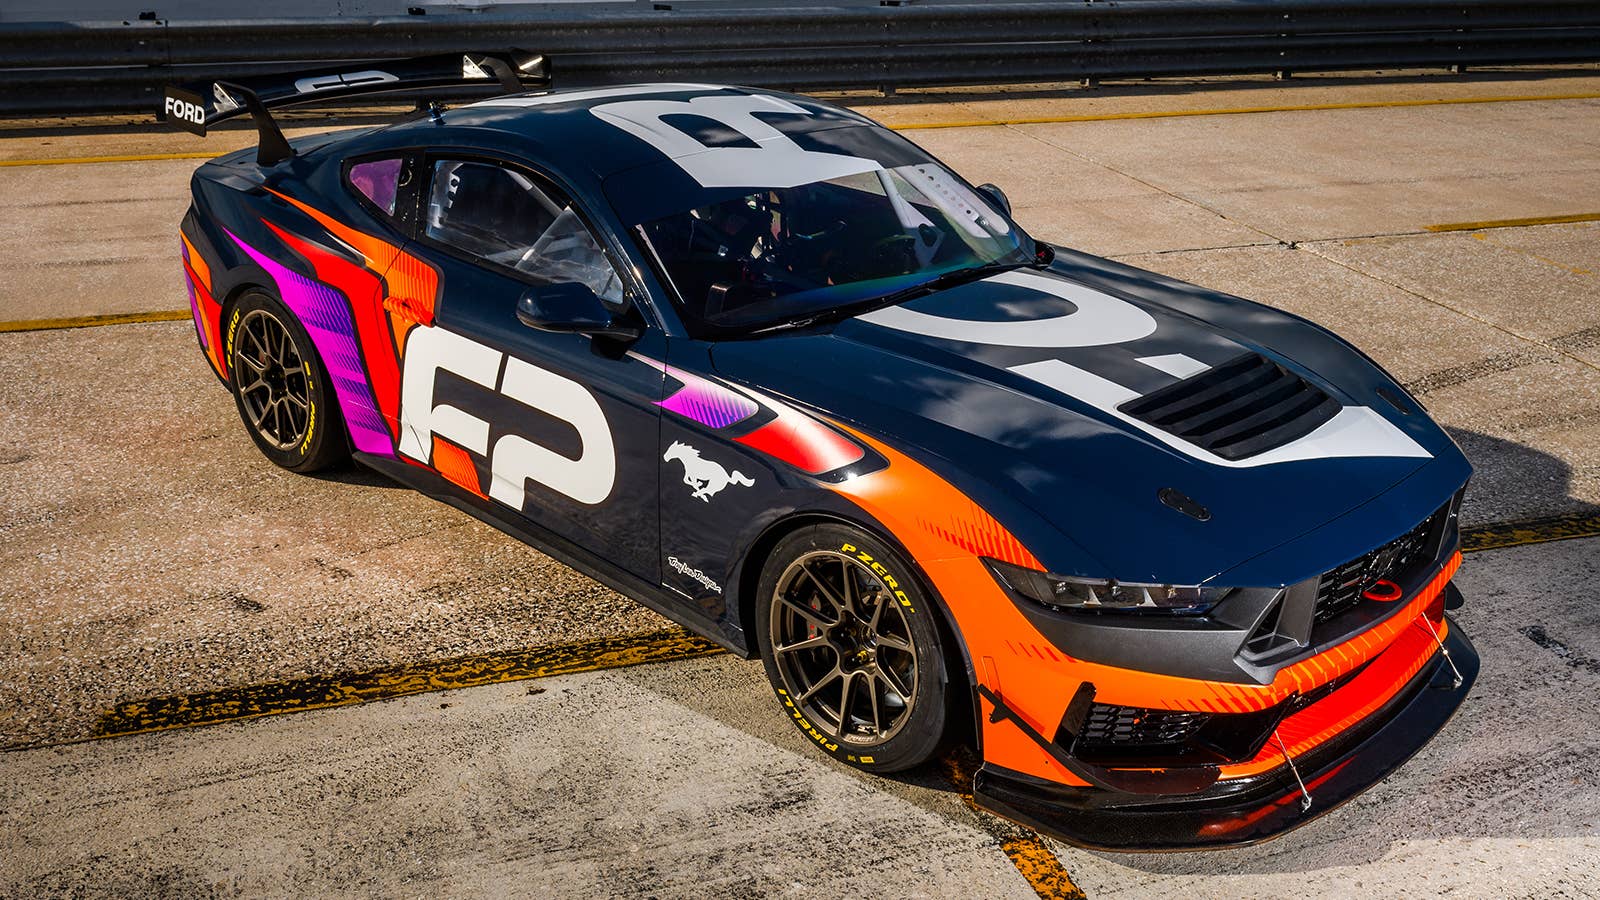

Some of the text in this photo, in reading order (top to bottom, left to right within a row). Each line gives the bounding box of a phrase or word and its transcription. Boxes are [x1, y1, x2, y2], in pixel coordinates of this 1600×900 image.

[165, 96, 205, 124] FORD
[398, 325, 616, 512] FP
[841, 543, 911, 607] P ZERO
[778, 688, 839, 752] PIRELLI
